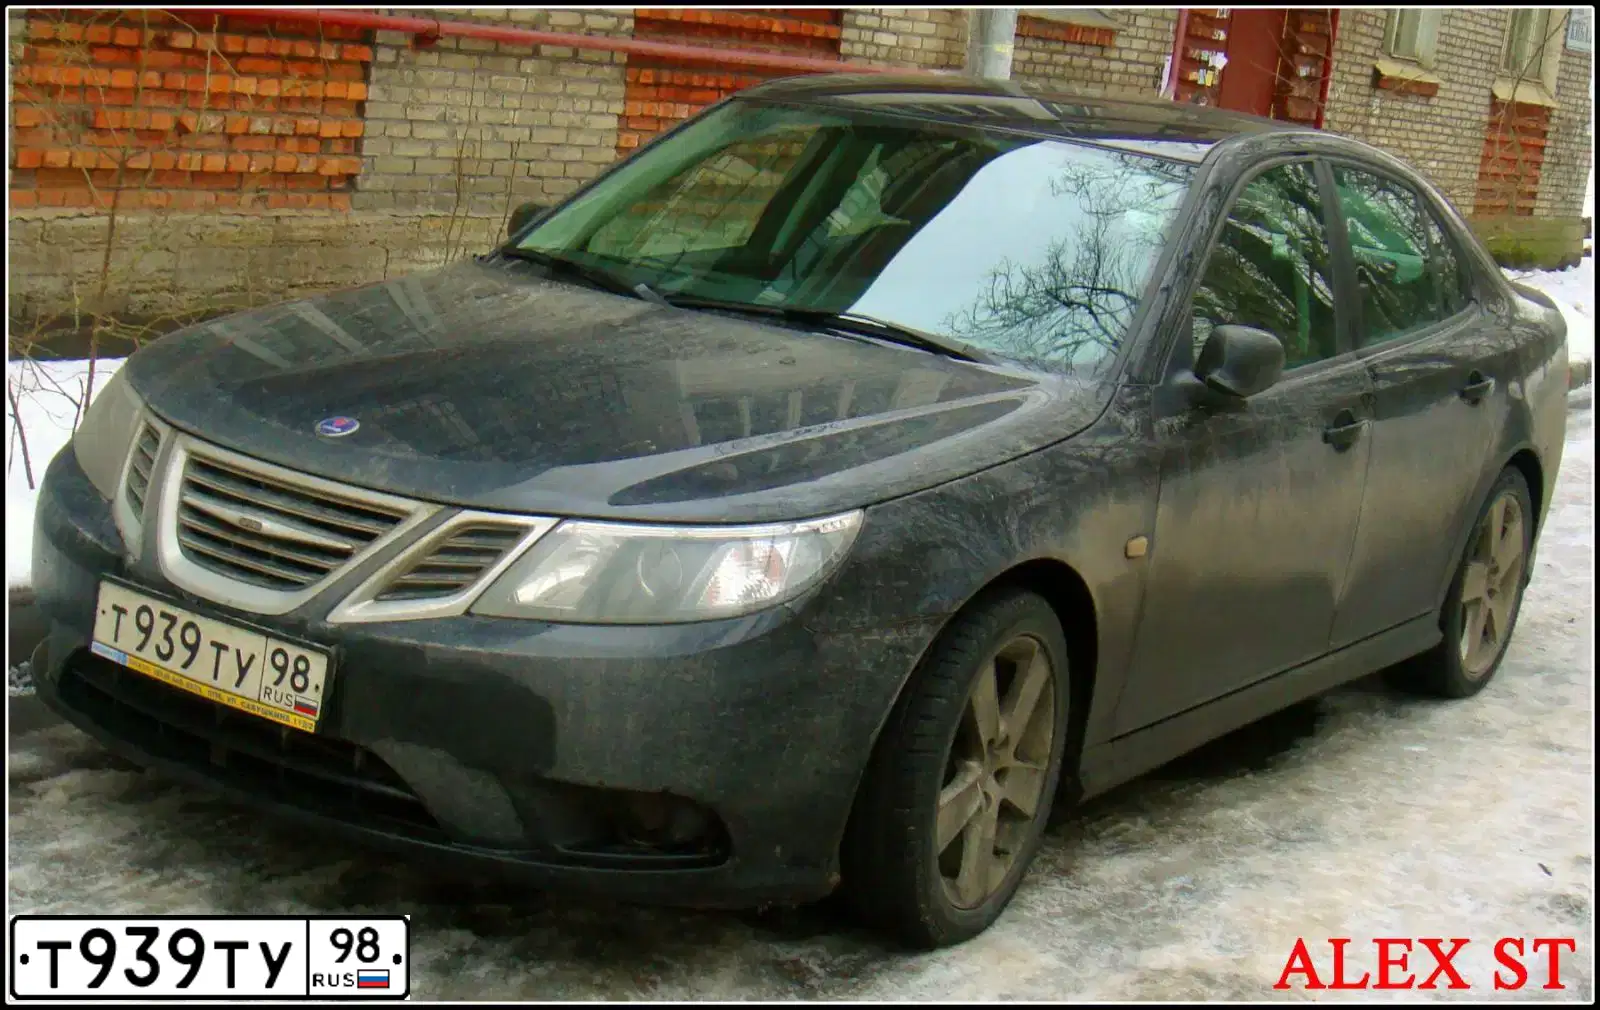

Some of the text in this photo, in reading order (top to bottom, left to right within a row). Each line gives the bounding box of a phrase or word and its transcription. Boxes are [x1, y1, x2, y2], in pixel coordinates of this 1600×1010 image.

[111, 603, 256, 689] Т939ТУ
[270, 647, 311, 694] 98
[263, 686, 293, 707] RUS
